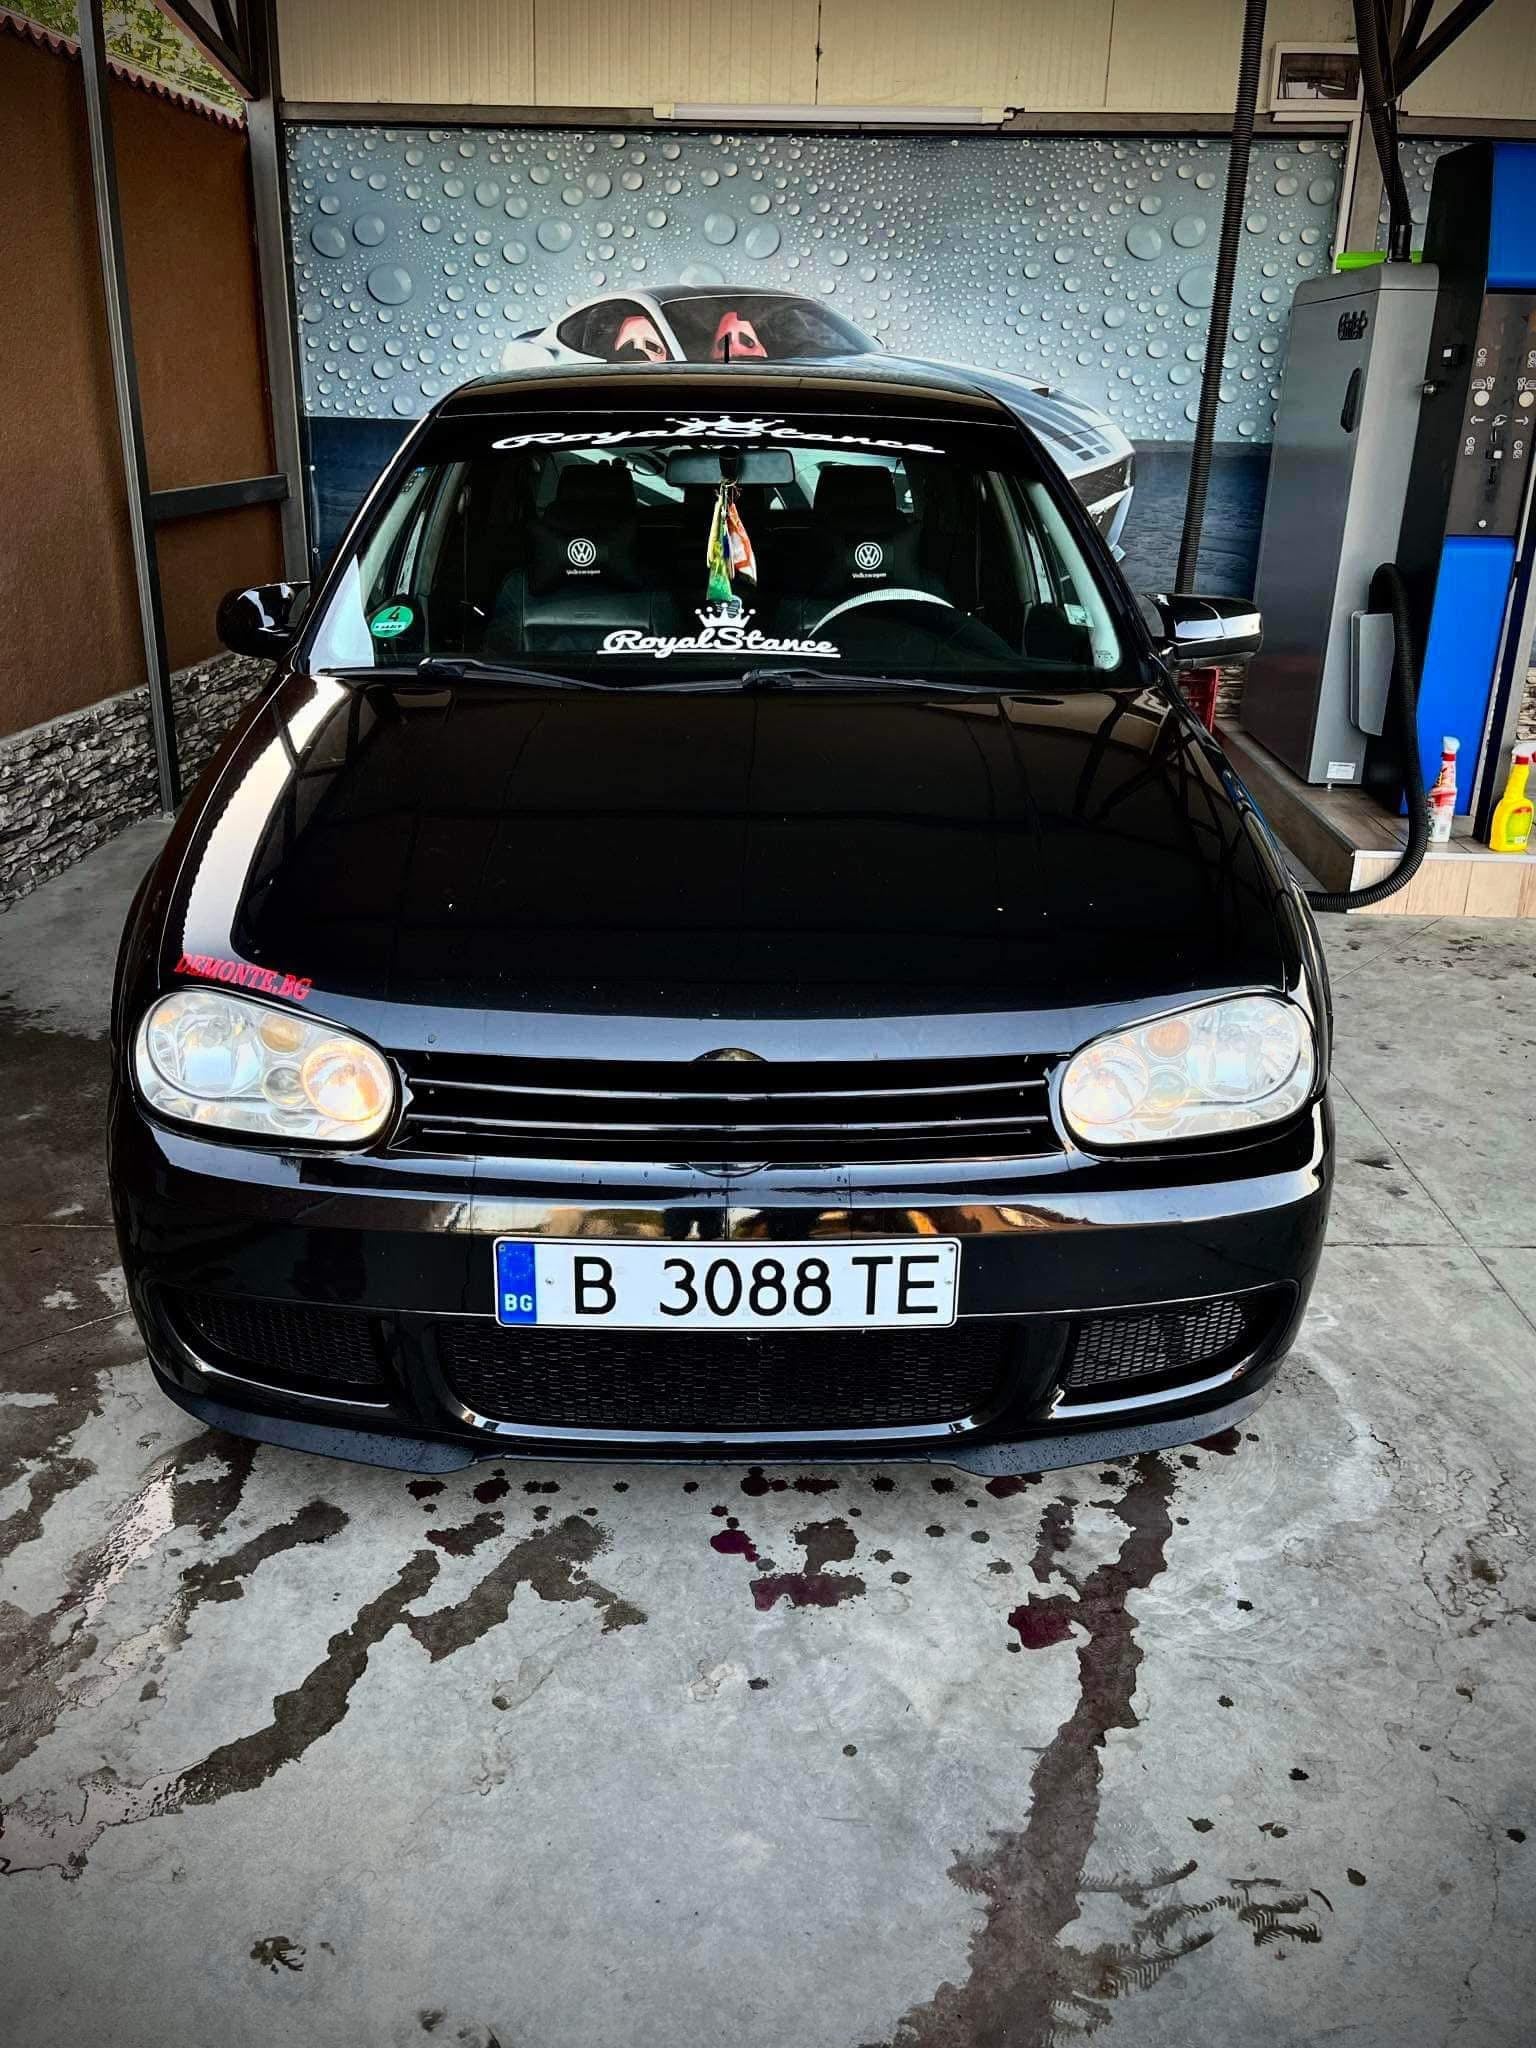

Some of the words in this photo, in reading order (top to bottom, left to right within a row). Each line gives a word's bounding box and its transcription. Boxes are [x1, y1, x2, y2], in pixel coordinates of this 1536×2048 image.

[388, 606, 401, 622] 4
[174, 954, 312, 999] DEMONTE.BG
[574, 1256, 617, 1315] B
[659, 1257, 832, 1317] 3088
[852, 1255, 939, 1315] TE
[504, 1294, 533, 1312] BG
